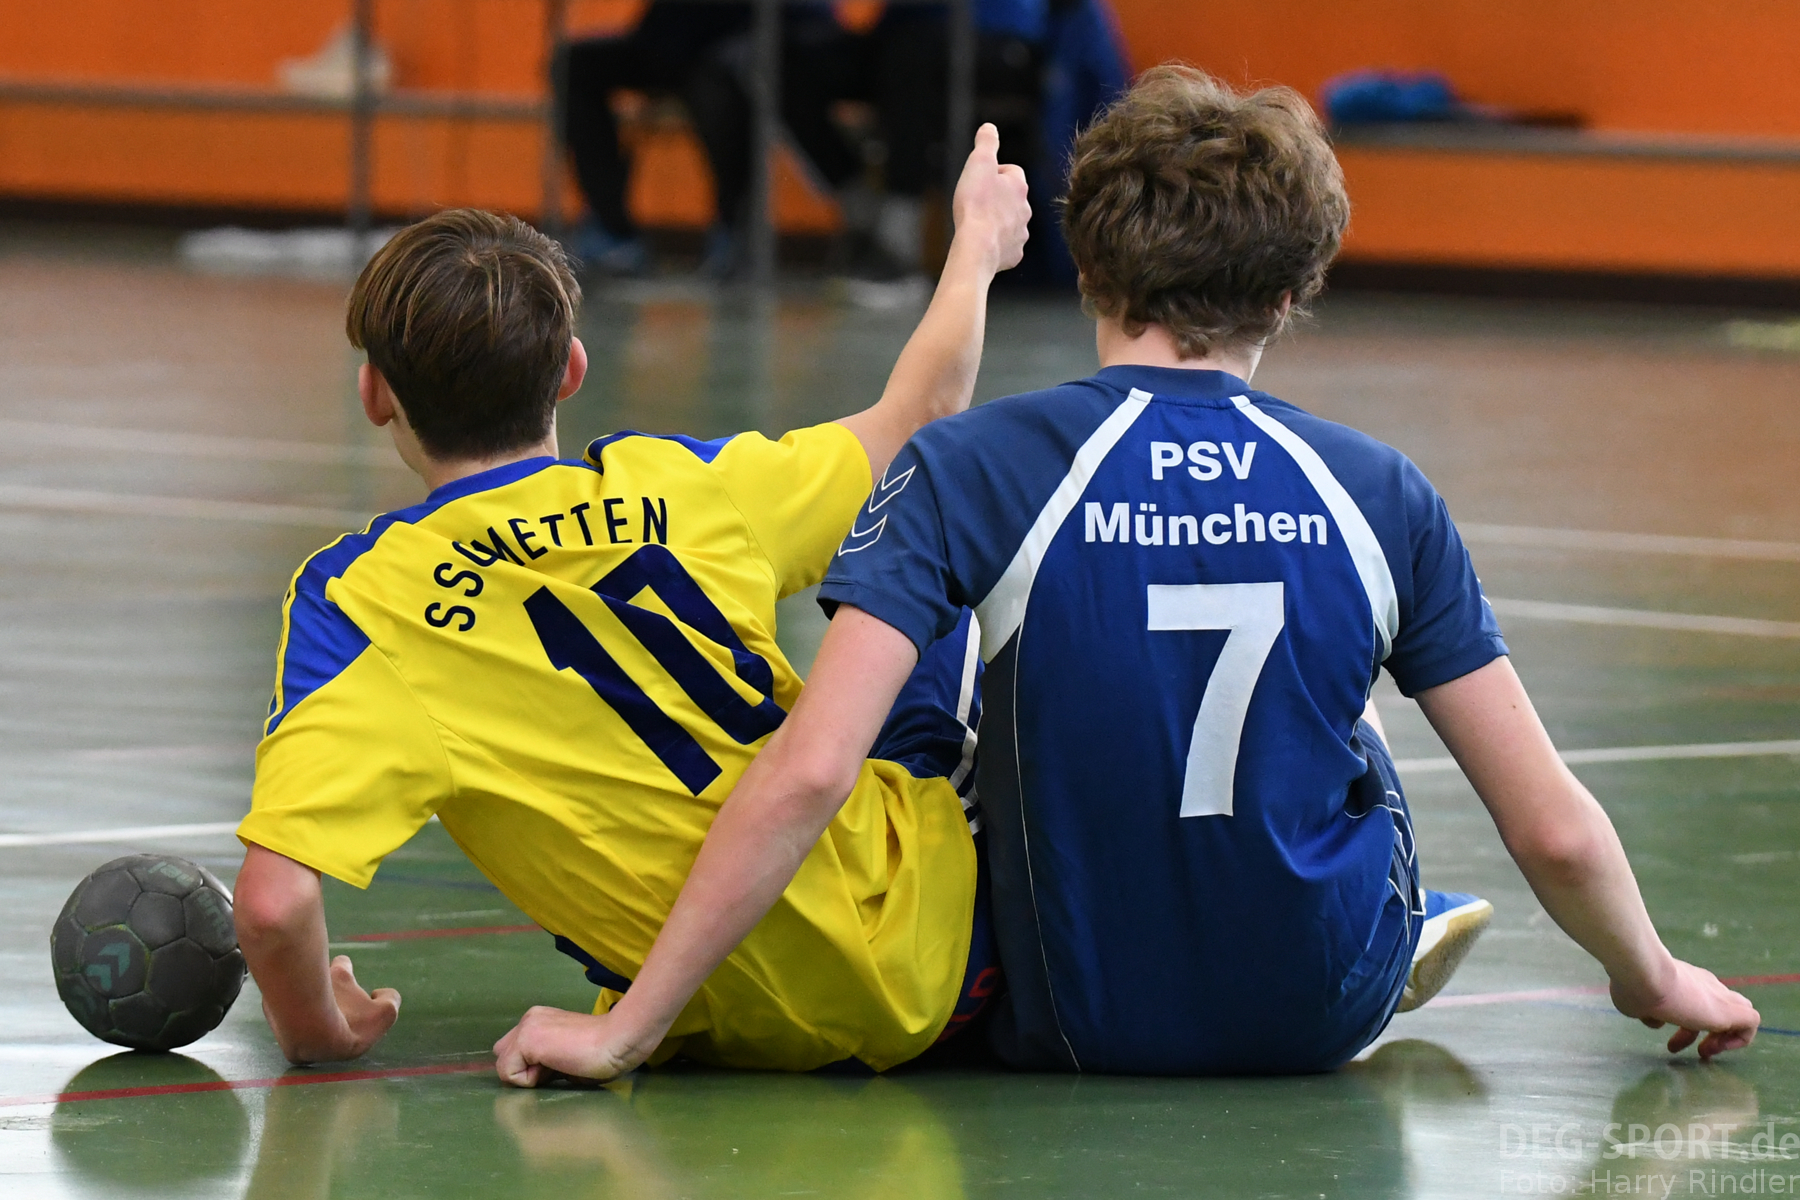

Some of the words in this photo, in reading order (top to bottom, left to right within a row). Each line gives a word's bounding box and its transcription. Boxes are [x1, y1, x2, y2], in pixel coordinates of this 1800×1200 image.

[1084, 501, 1328, 546] München
[1150, 441, 1257, 481] PSV
[522, 543, 788, 797] 10
[1147, 581, 1285, 818] 7
